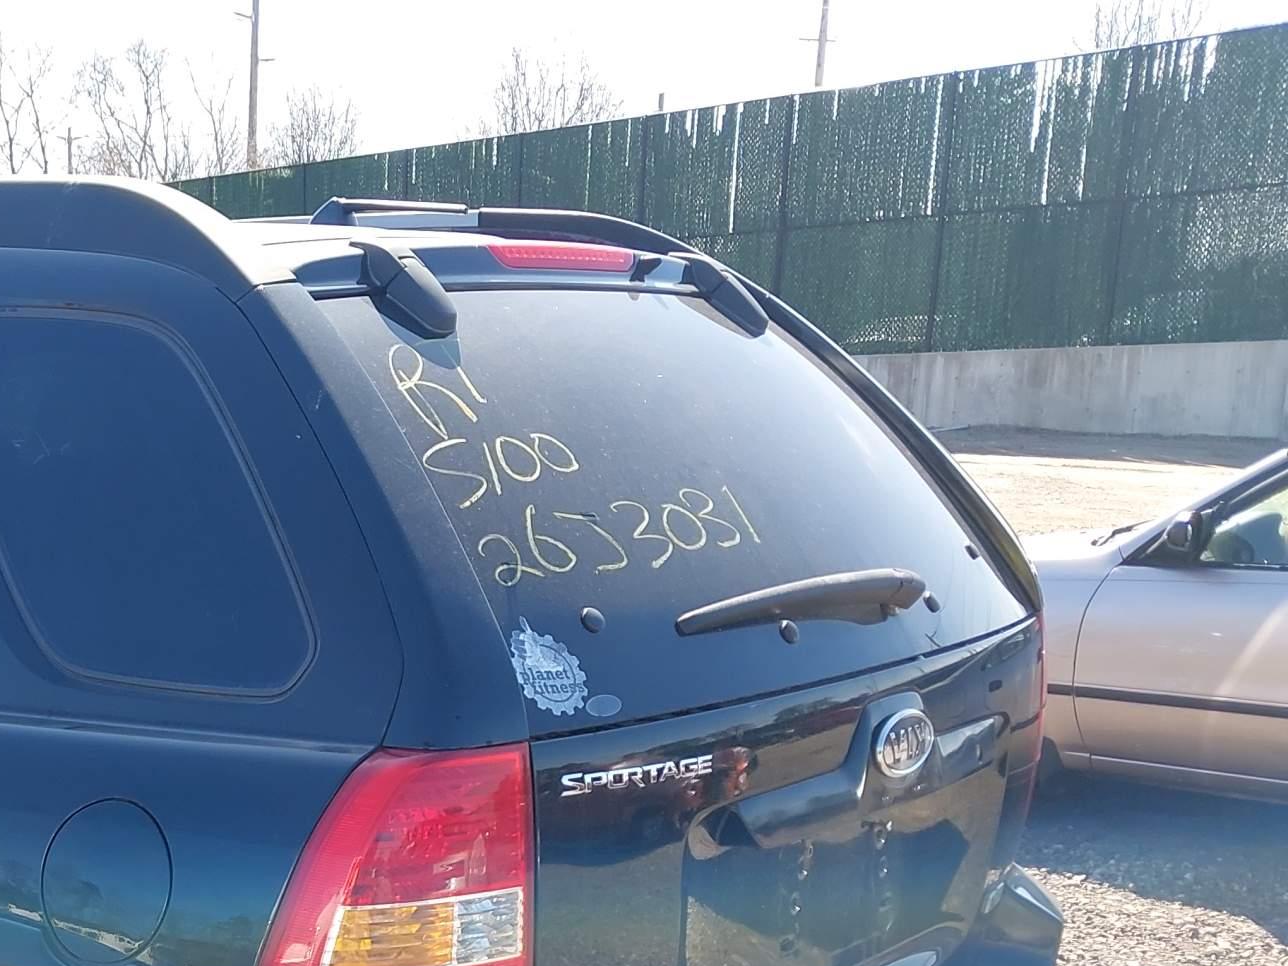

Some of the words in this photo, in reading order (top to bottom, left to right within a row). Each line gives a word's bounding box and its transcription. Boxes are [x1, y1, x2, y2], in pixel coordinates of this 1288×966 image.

[423, 433, 579, 508] S100
[519, 664, 570, 686] planet
[530, 680, 585, 695] fitness
[561, 755, 713, 798] SPORTAGE
